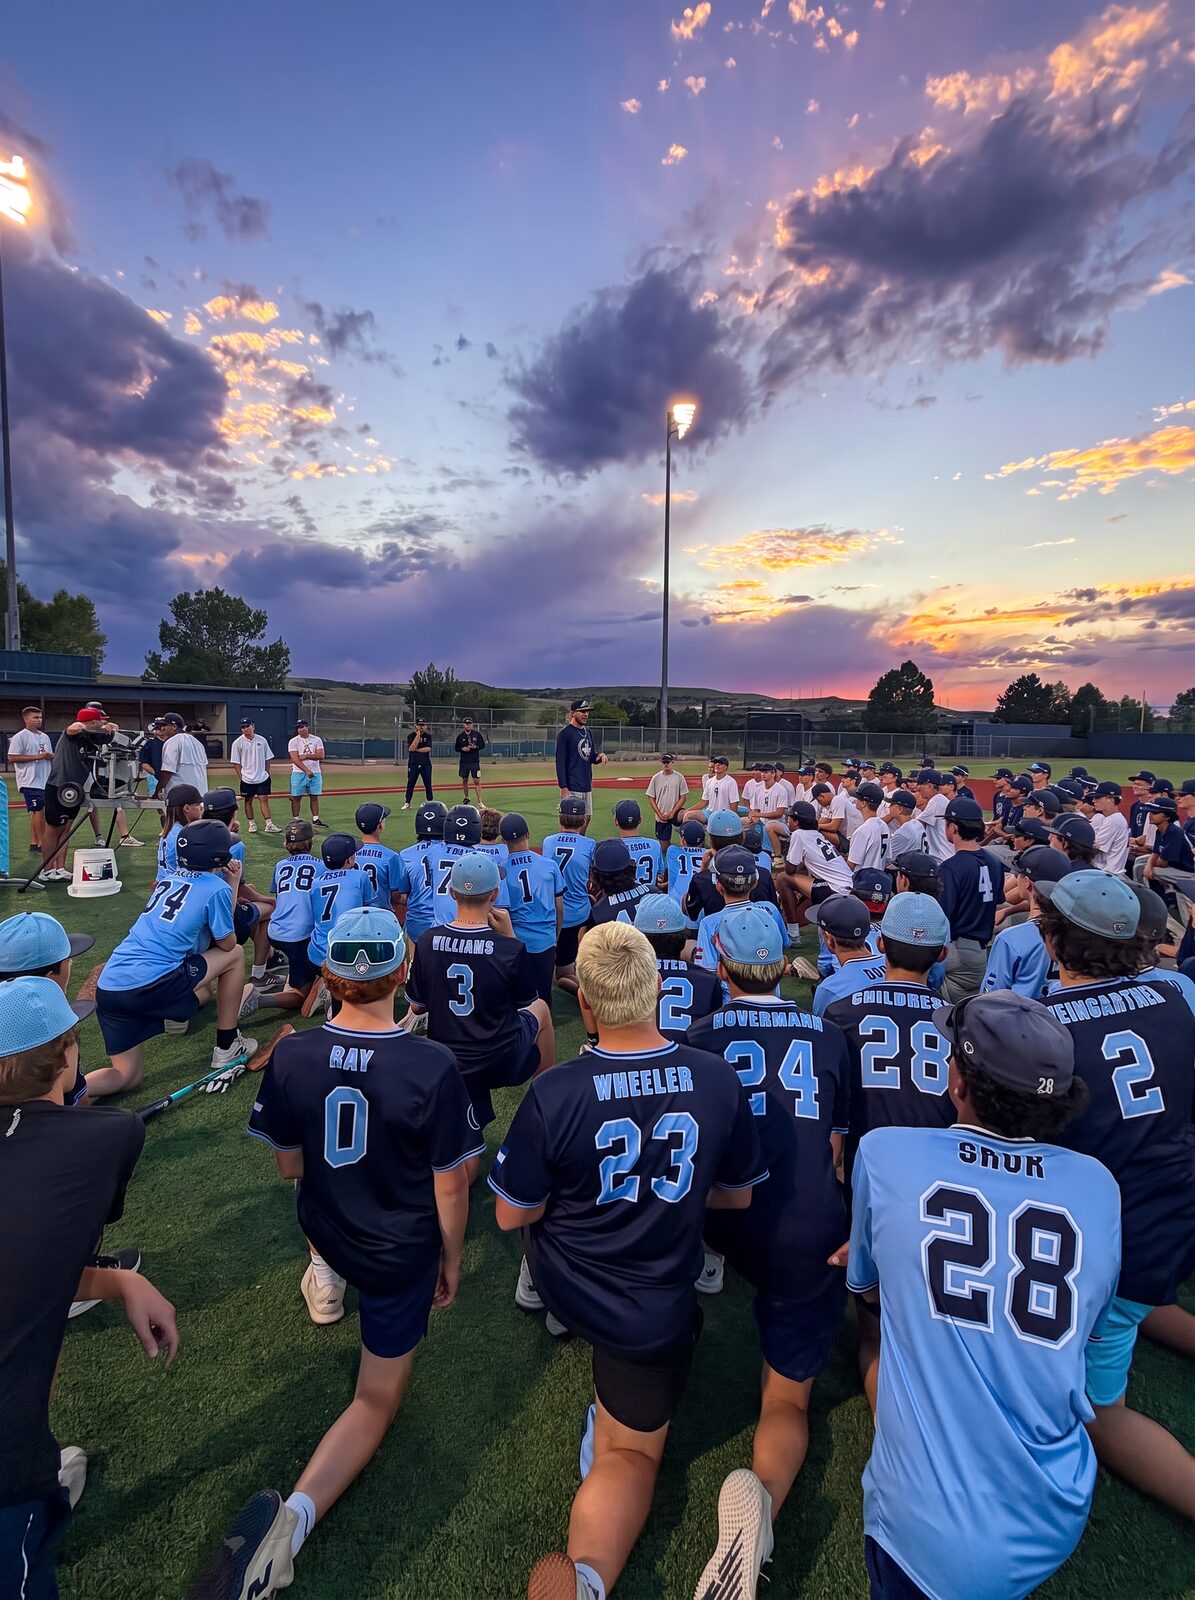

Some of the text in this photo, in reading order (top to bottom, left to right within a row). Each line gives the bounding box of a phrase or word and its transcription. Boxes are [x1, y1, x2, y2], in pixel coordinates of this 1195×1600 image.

[277, 863, 317, 895] 28
[556, 846, 575, 877] 7
[320, 883, 341, 922] 7
[518, 868, 533, 905] 1
[978, 865, 994, 903] 4
[432, 935, 495, 955] WILLIAMS
[446, 963, 475, 1017] 3
[659, 976, 694, 1031] 2
[712, 1010, 823, 1032] HOVERMANN
[329, 1045, 375, 1072] RAY
[859, 1014, 952, 1096] 28
[592, 1066, 694, 1101] WHEELER
[723, 1038, 820, 1121] 24
[1036, 1077, 1054, 1094] 28
[1101, 1029, 1166, 1120] 2
[324, 1086, 369, 1169] 0
[594, 1111, 699, 1205] 23
[919, 1180, 1083, 1351] 28
